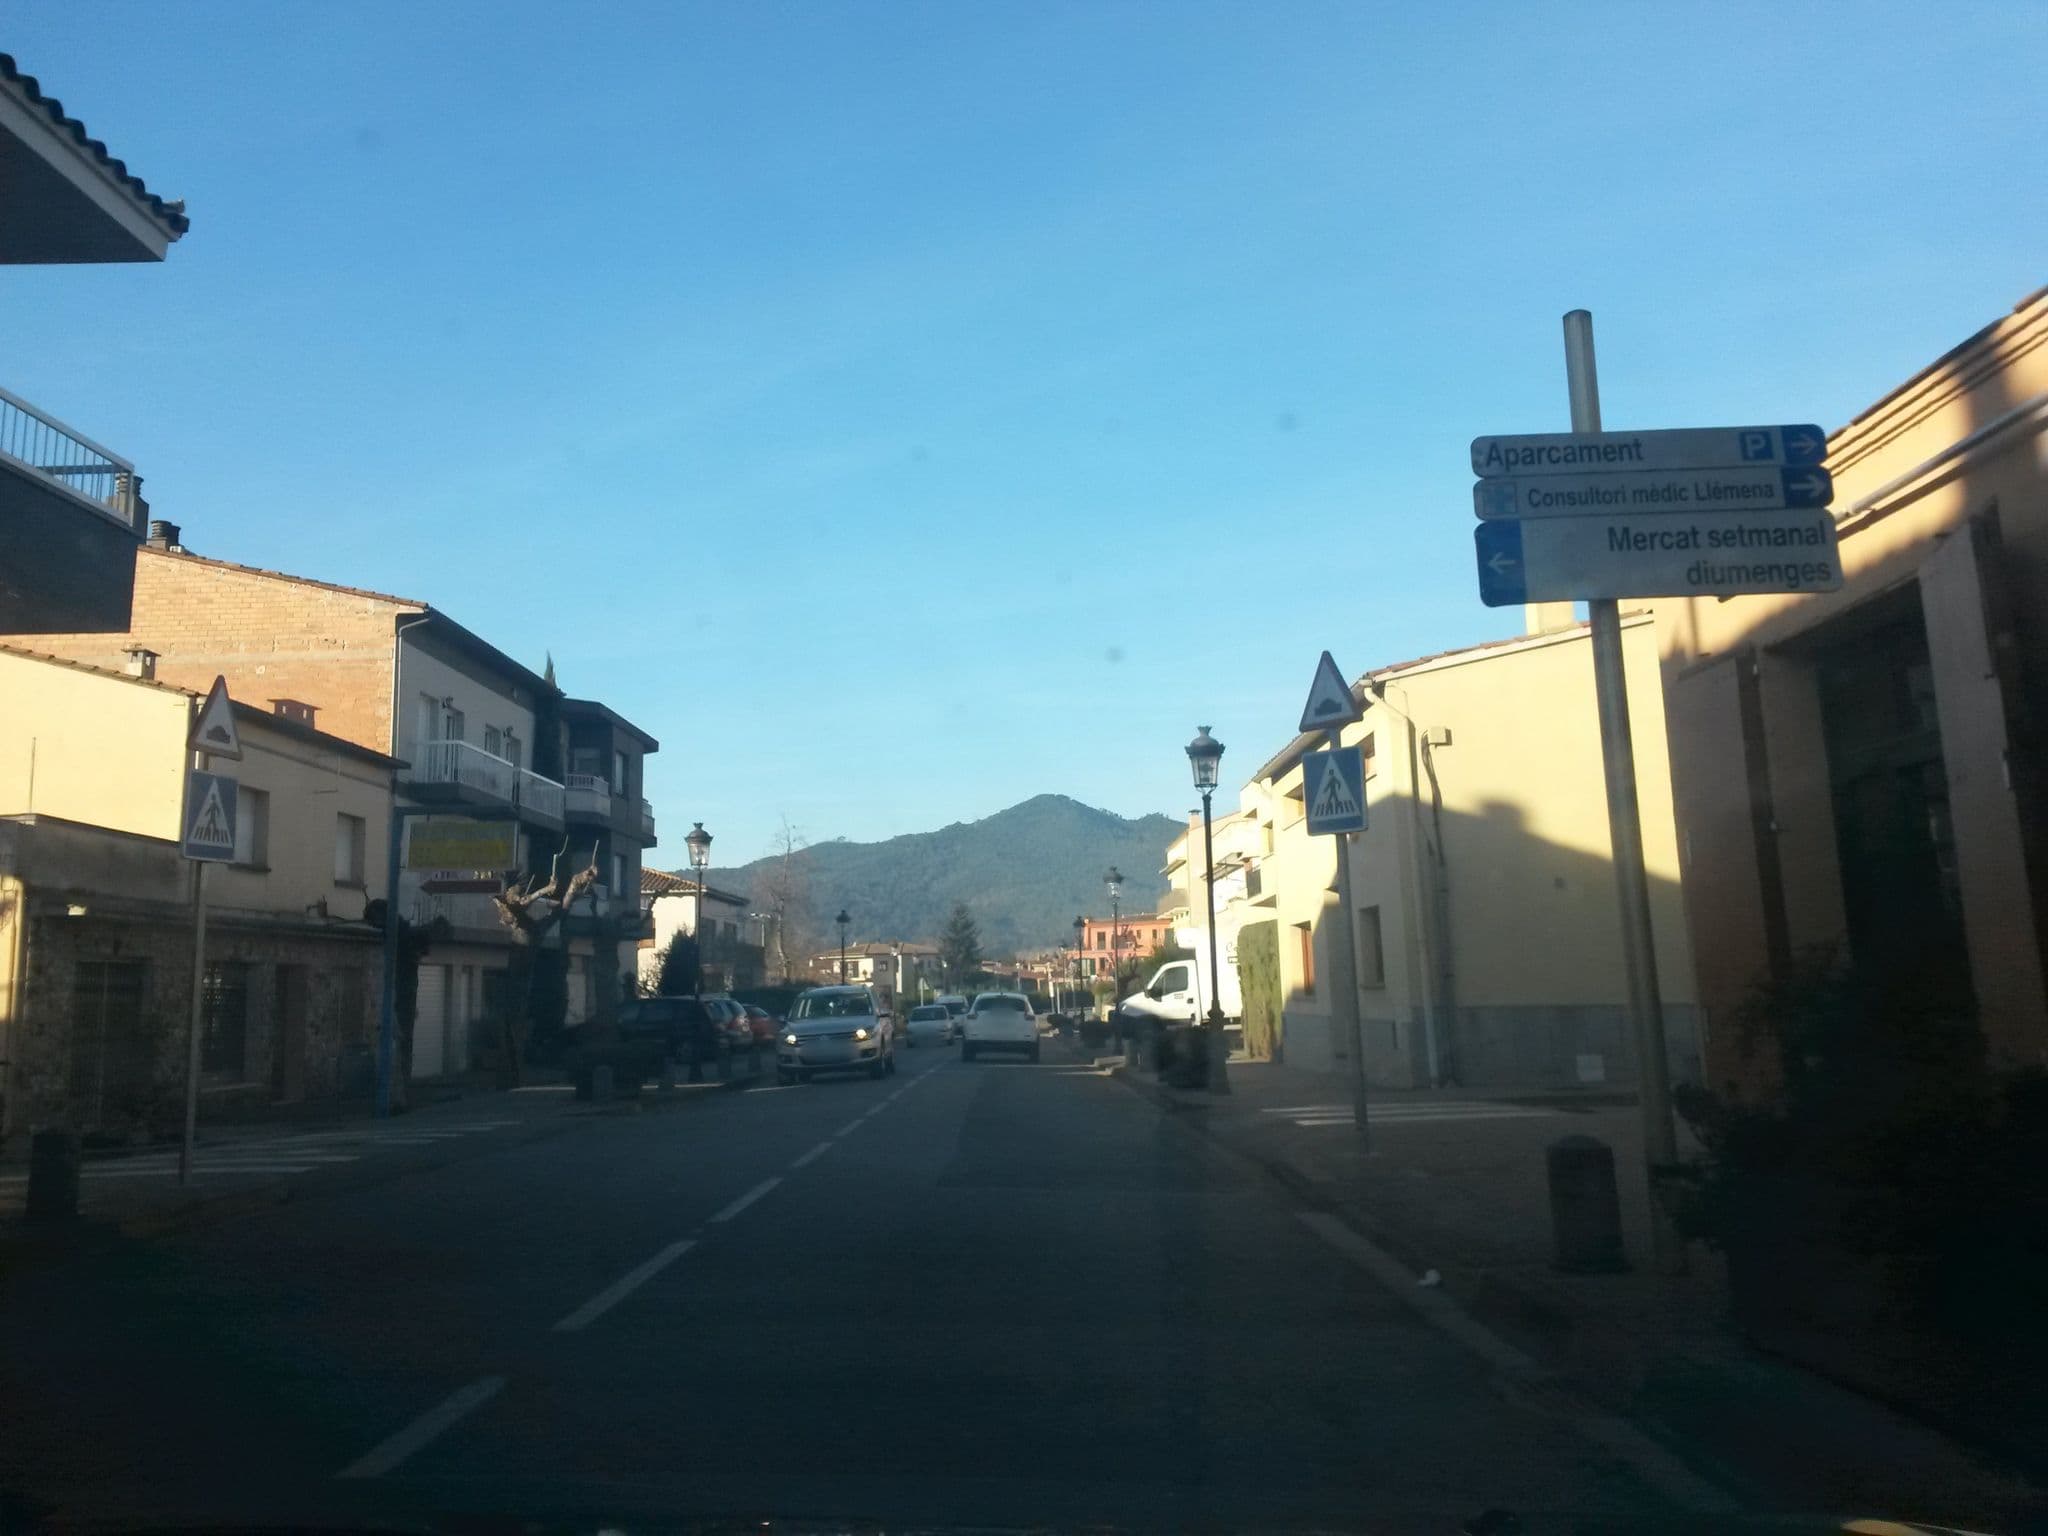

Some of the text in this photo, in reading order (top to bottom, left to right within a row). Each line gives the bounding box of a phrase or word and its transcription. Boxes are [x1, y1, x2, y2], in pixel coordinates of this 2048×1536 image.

[1486, 438, 1645, 472] Aparcament
[1746, 434, 1767, 457] P
[1528, 484, 1628, 507] Consultori
[1632, 481, 1689, 503] mèdic
[1608, 520, 1827, 552] Mercat setmanal
[1686, 561, 1832, 589] diumenges
